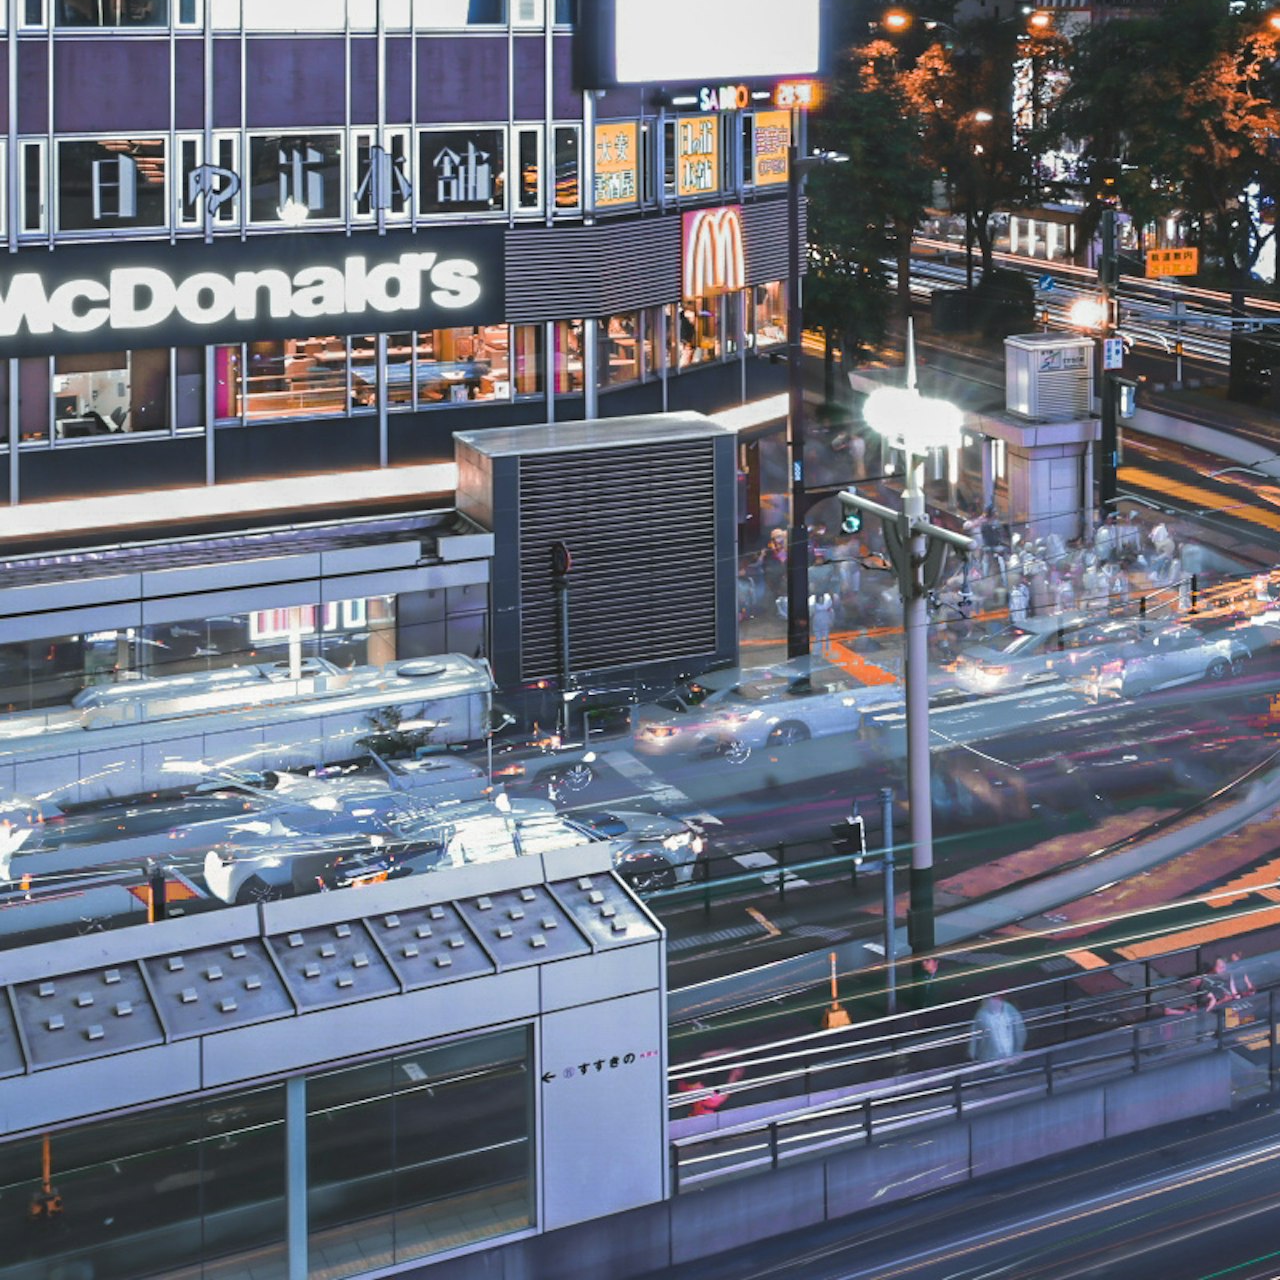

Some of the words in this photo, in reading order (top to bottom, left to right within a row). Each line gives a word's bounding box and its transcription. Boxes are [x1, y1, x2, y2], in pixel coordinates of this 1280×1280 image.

[0, 252, 482, 338] McDonald's
[578, 1052, 636, 1076] すすきの
